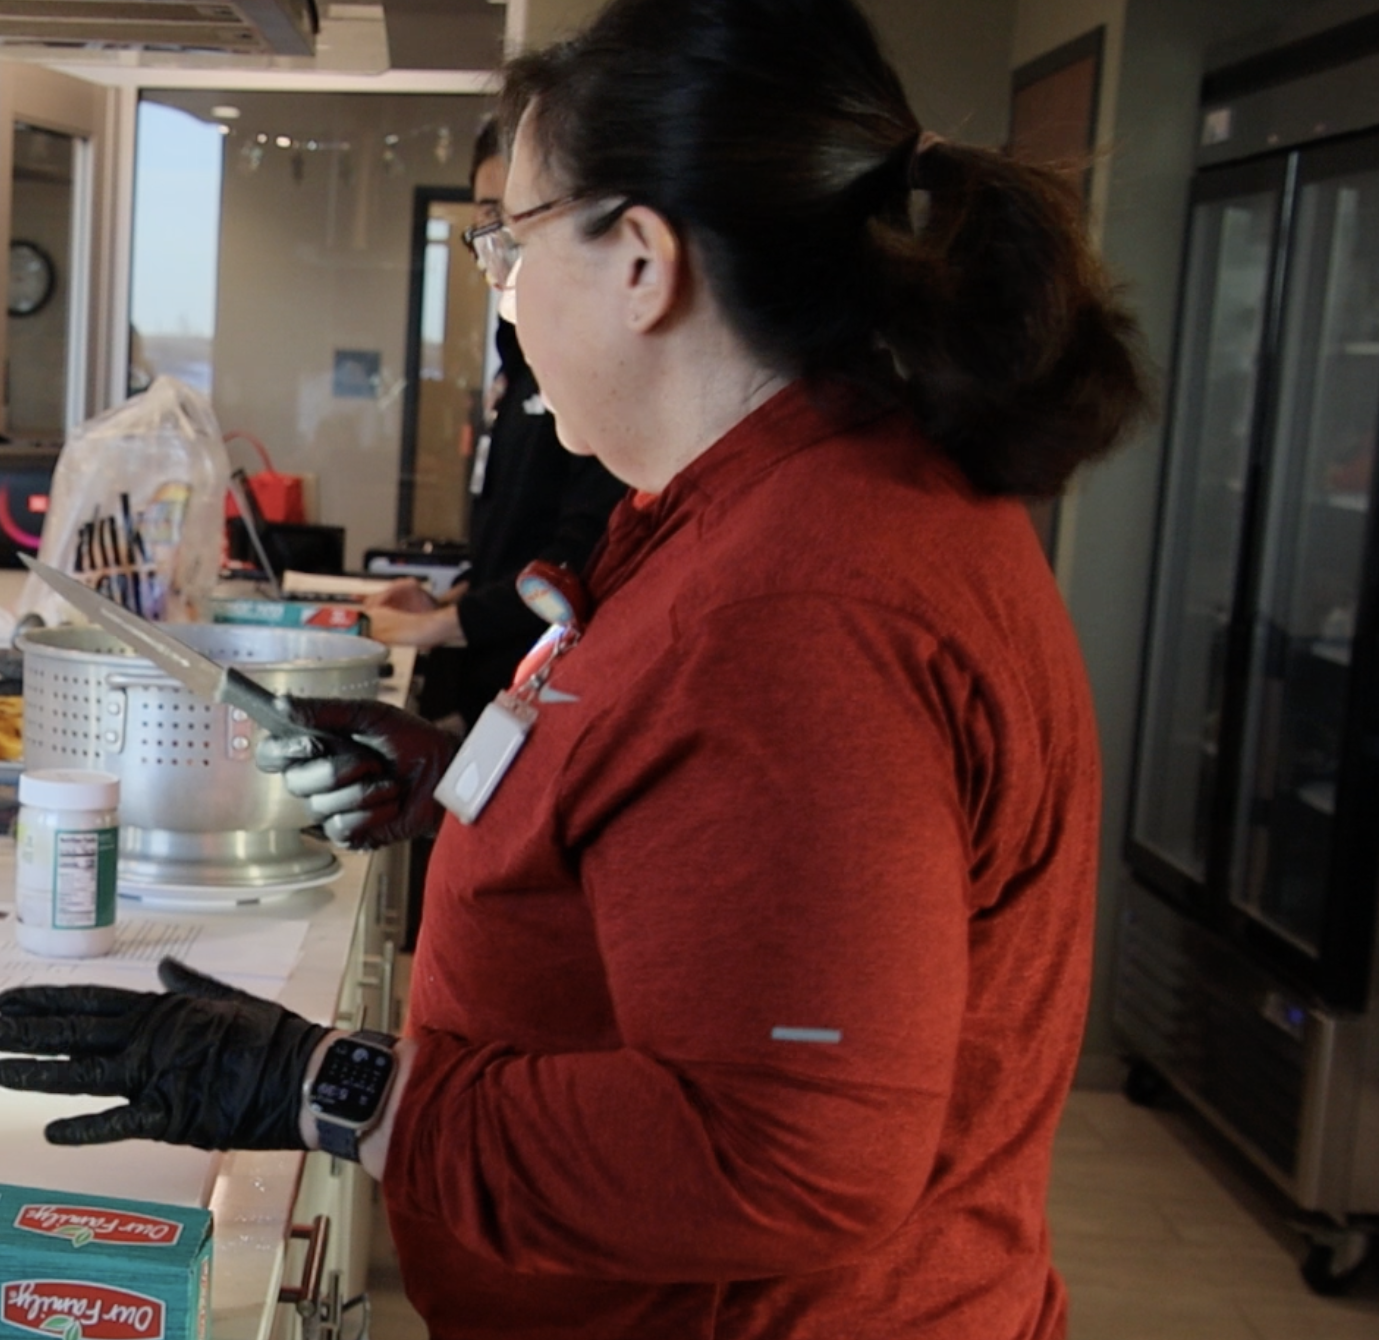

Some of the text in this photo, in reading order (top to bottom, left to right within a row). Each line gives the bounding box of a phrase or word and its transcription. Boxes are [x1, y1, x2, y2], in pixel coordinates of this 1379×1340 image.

[29, 1206, 170, 1239] Our Family
[8, 1282, 153, 1331] Our Family
